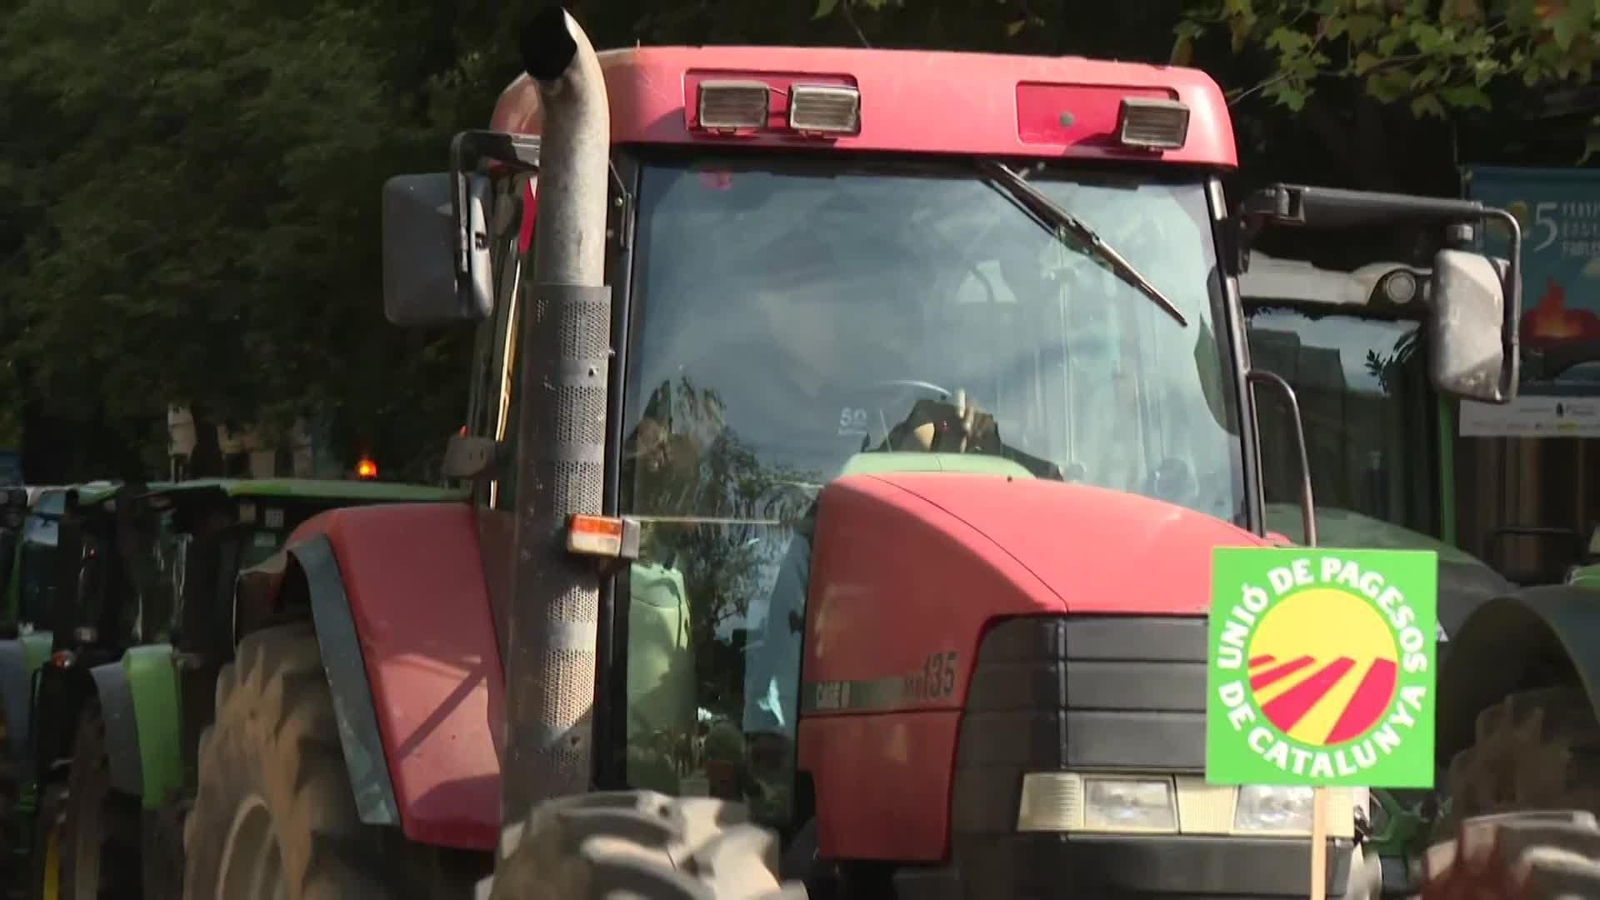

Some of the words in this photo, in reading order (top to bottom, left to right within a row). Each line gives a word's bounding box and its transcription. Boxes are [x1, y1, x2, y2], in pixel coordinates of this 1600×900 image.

[1533, 202, 1558, 253] 5
[1216, 583, 1269, 670] UNIÓ
[1267, 558, 1314, 596] DE
[1320, 556, 1428, 674] PAGESOS
[1218, 680, 1256, 731] DE
[1247, 685, 1427, 779] CATALUNYA
